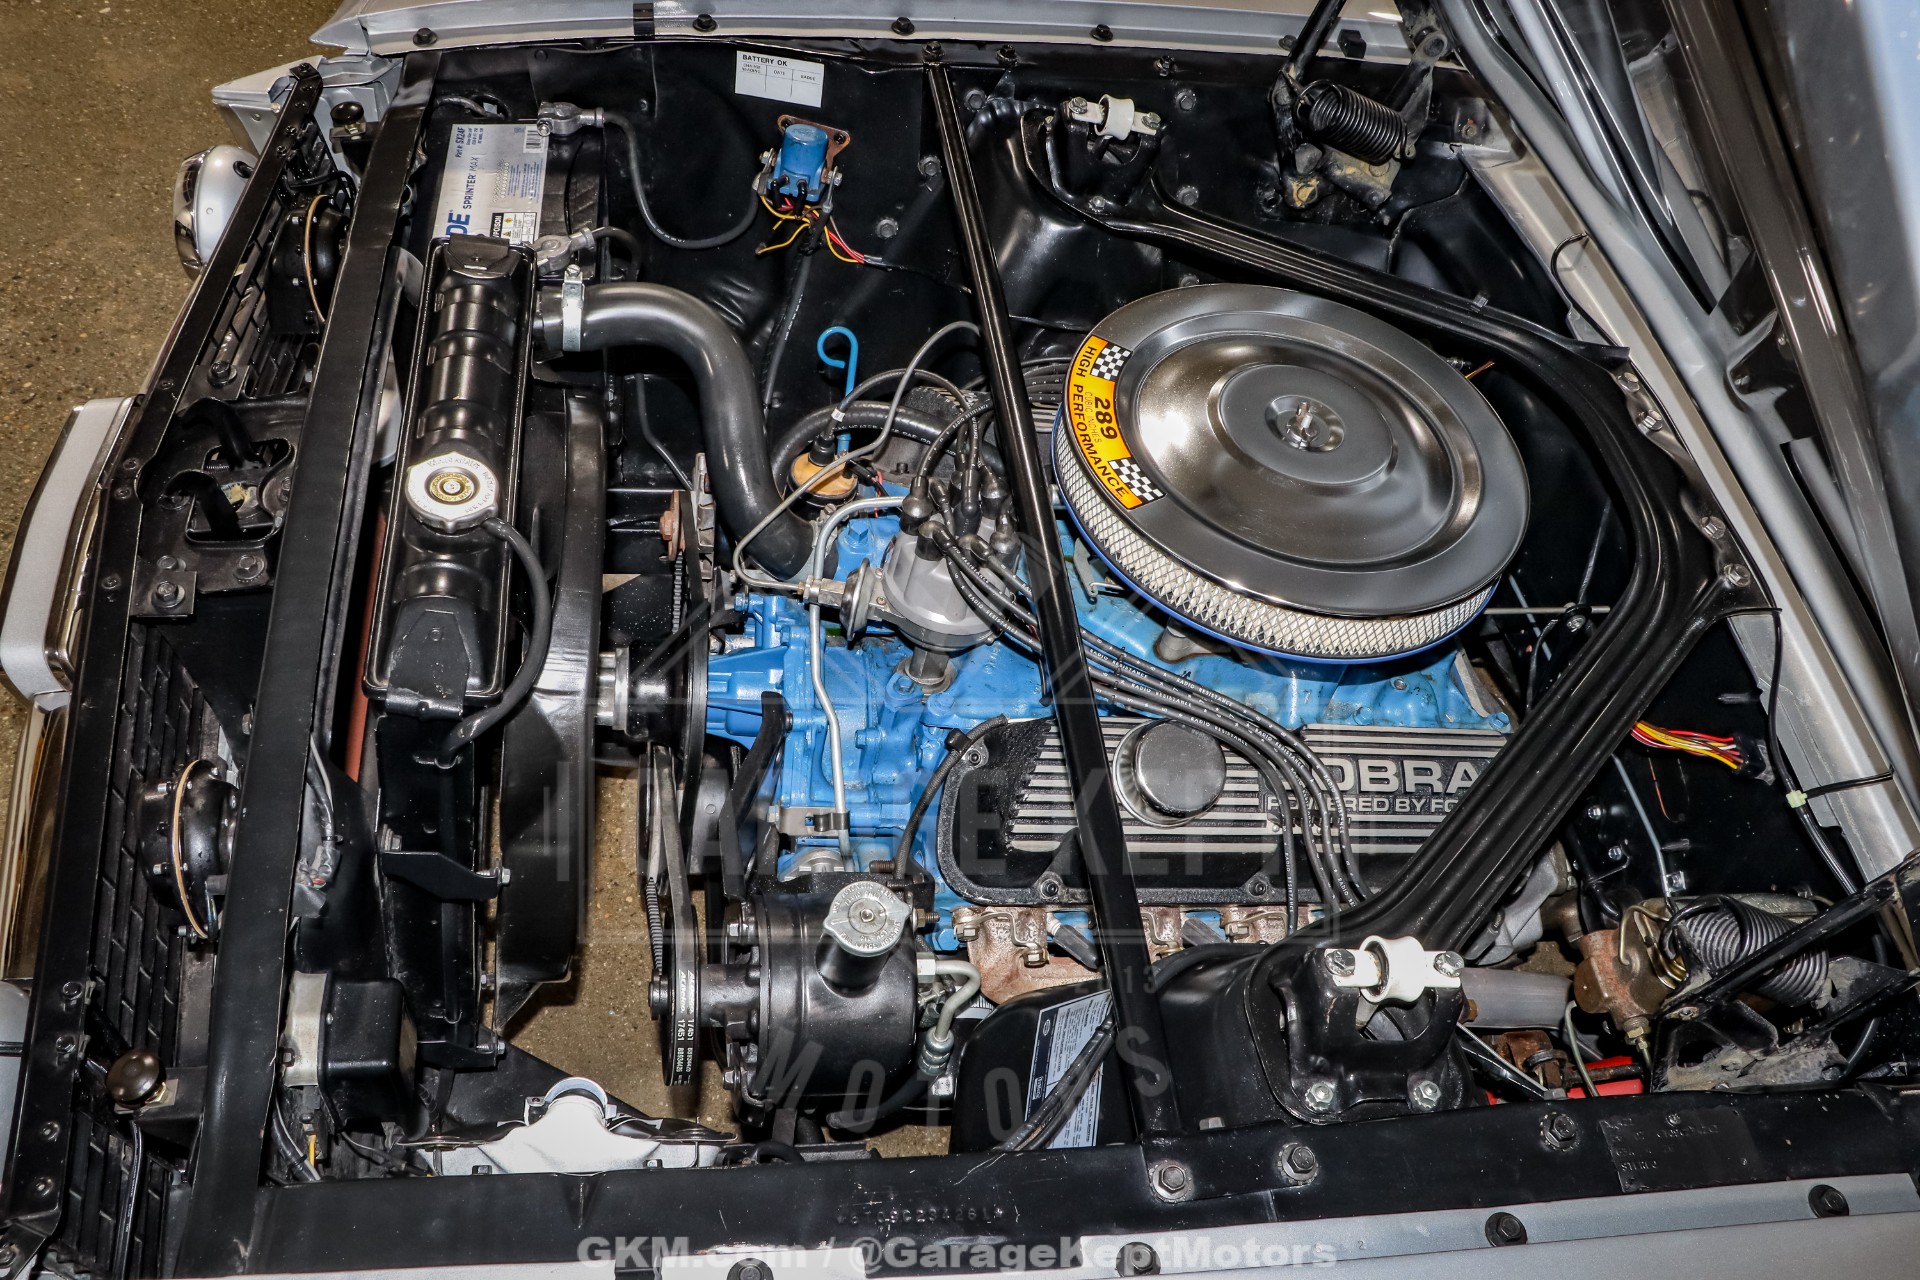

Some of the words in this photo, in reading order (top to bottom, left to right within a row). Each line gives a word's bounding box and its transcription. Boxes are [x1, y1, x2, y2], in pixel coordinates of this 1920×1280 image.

[742, 54, 774, 65] BATTERY
[469, 156, 480, 172] MAX
[463, 174, 477, 209] SPRINTER
[1076, 346, 1097, 377] HIGH
[1084, 391, 1093, 413] CUBIC
[1087, 416, 1102, 443] INCHES
[1094, 396, 1117, 440] 289
[1073, 383, 1130, 497] PERFORMANCE
[1280, 757, 1480, 793] OBRA
[1395, 798, 1428, 812] BY
[677, 1018, 685, 1041] 17451
